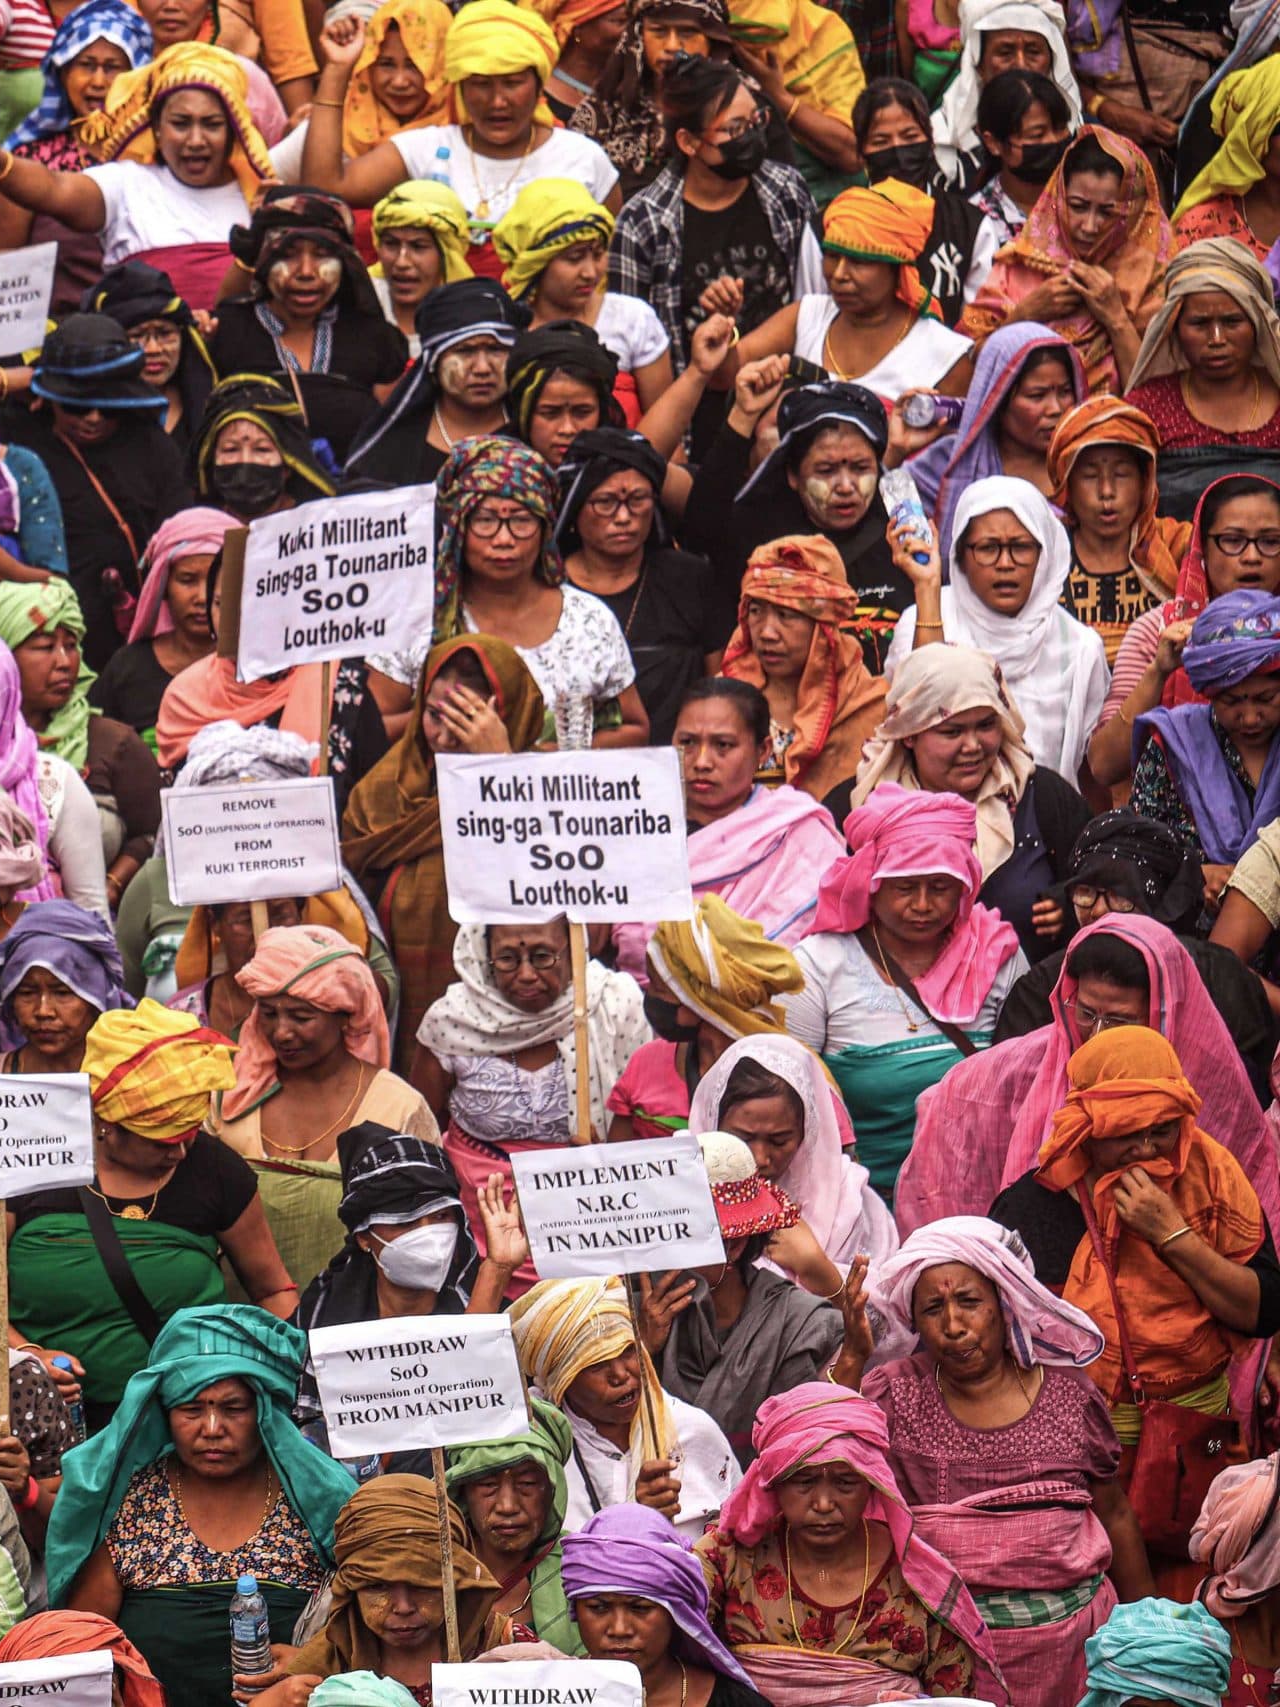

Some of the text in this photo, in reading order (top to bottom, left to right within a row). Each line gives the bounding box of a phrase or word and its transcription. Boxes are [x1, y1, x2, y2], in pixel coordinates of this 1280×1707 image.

[278, 512, 407, 559] Kuki Millitant
[325, 544, 427, 579] Tounariba
[302, 583, 369, 614] SoO
[284, 616, 385, 650] Louthok-u
[479, 774, 641, 802] Kuki Millitant
[222, 799, 277, 812] REMOVE
[178, 825, 203, 837] SoO
[264, 822, 271, 830] of
[457, 809, 671, 843] sing-ga Tounariba
[234, 839, 272, 851] FROM
[530, 844, 605, 870] SoO
[205, 857, 306, 875] KUKI TERRORIST
[509, 880, 628, 906] Louthok-u
[6, 1135, 67, 1150] Operation)
[533, 1159, 678, 1190] IMPLEMENT
[577, 1192, 638, 1214] N.R.C
[546, 1222, 692, 1252] IN MANIPUR
[346, 1335, 468, 1363] WITHDRAW
[391, 1364, 428, 1382] SoO
[340, 1377, 494, 1405] (Suspension of Operation)
[337, 1393, 506, 1426] FROM MANIPUR
[469, 1688, 598, 1705] WITHDRAW
